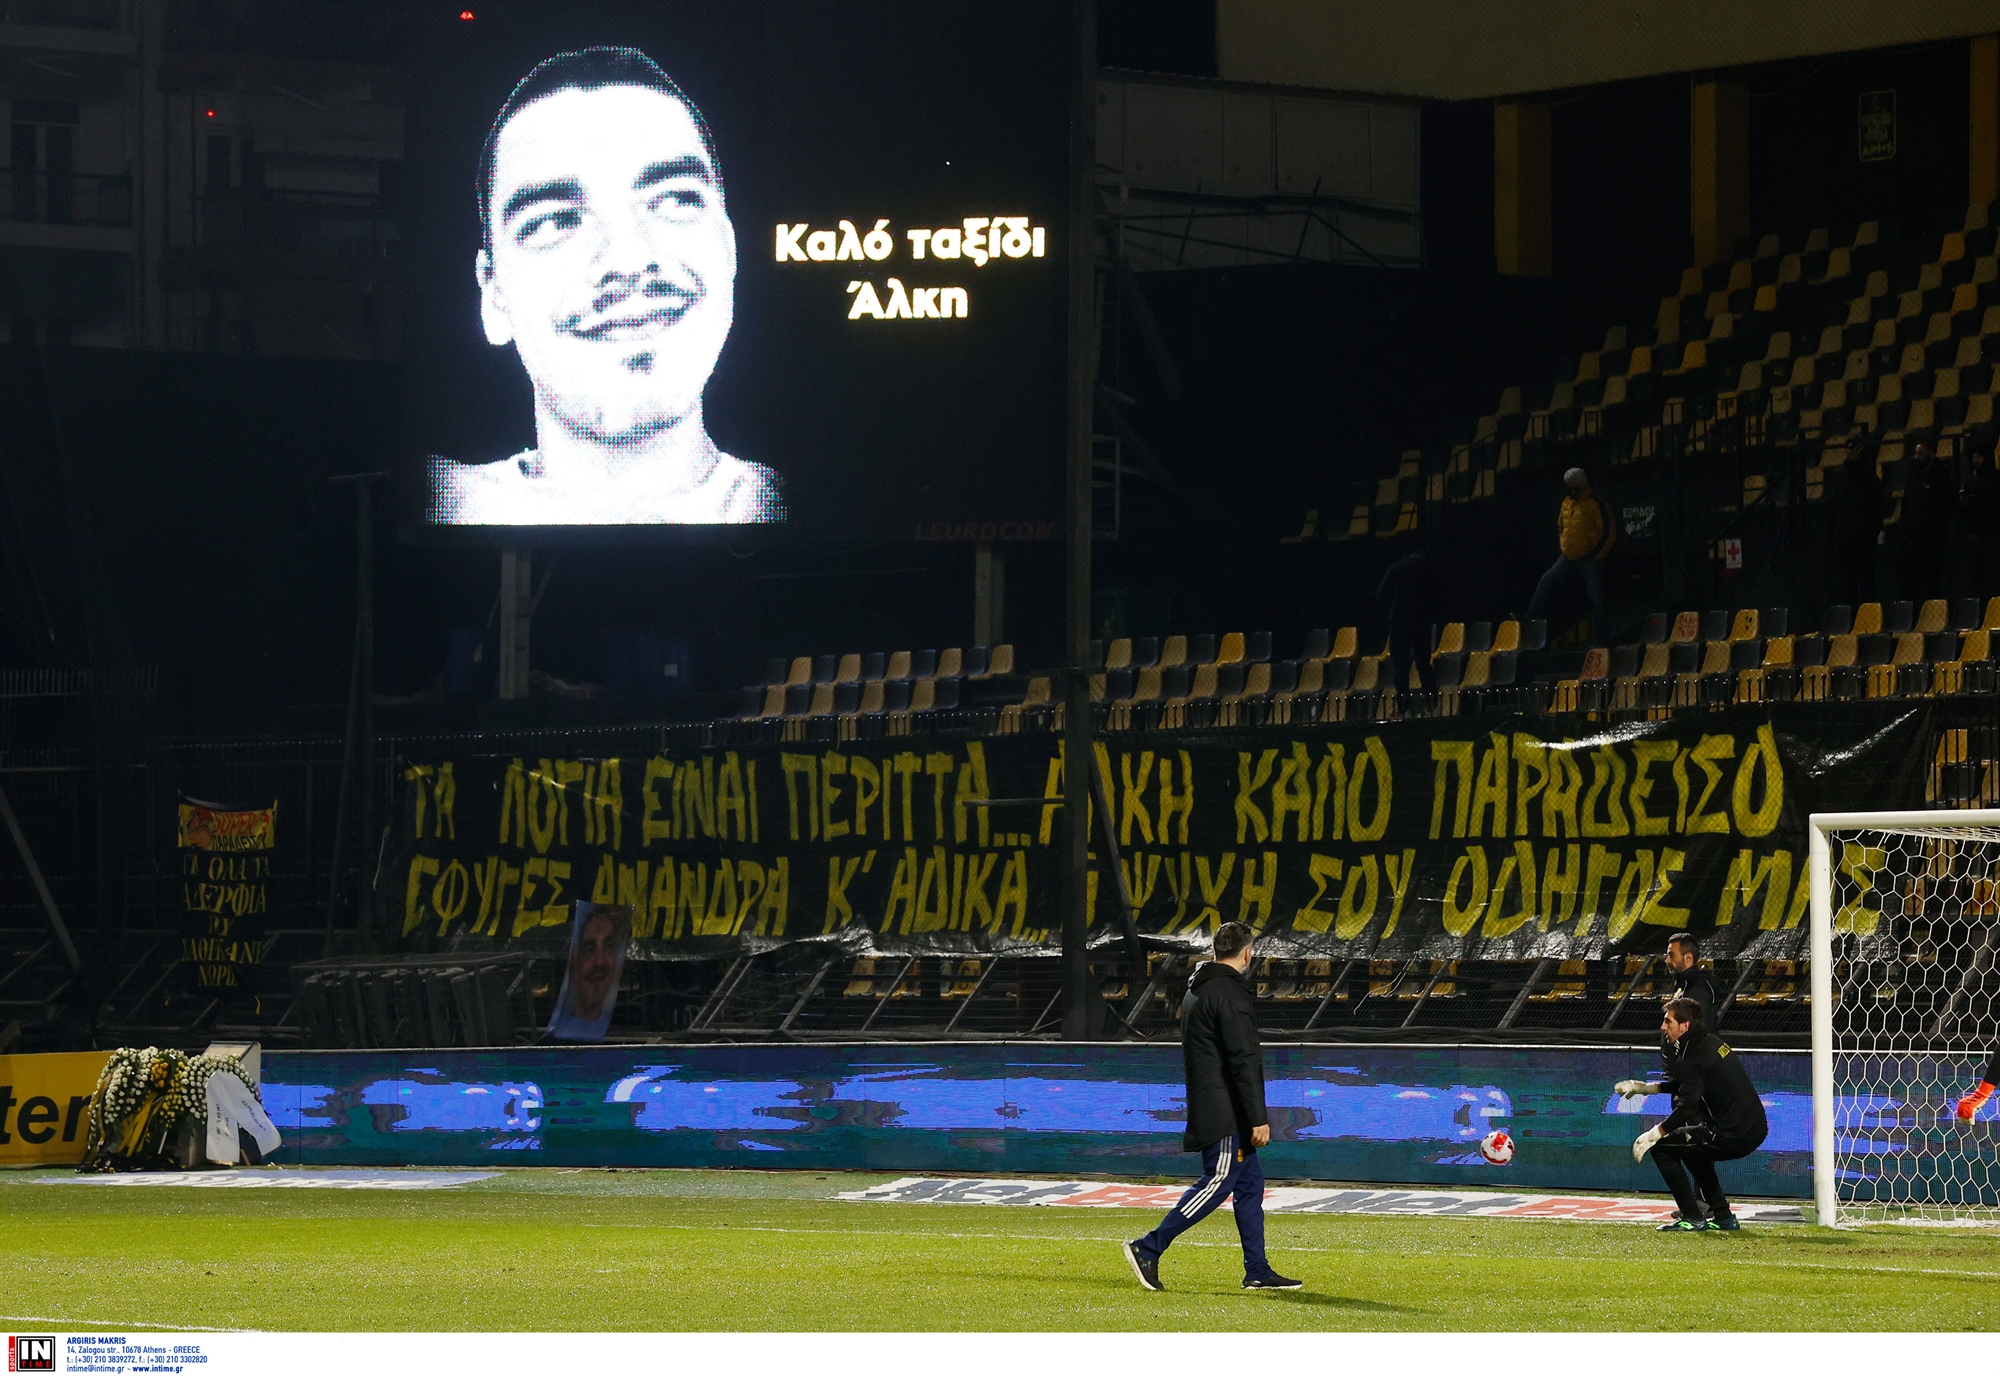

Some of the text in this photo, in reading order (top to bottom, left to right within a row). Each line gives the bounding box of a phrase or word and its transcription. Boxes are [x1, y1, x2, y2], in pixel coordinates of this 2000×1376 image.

[775, 216, 1046, 267] Καλό ταξίδι
[846, 277, 968, 319] Άλκη
[405, 761, 455, 840] ΤΑ
[500, 757, 622, 853] ΛΟΓΙΑ
[642, 750, 759, 846] ΕΙΝΑΙ
[1234, 736, 1394, 843] ΚΑΛΟ
[1429, 721, 1785, 840] ΠΑΡΑΔΕΙΣΟ
[404, 854, 571, 938] ΕΦΥΓΕΣ
[1121, 851, 1279, 938] ΨΥΧΗ
[1291, 848, 1416, 941] ΣΟΥ
[1442, 840, 1690, 943] ΟΔΗΓΟΣ
